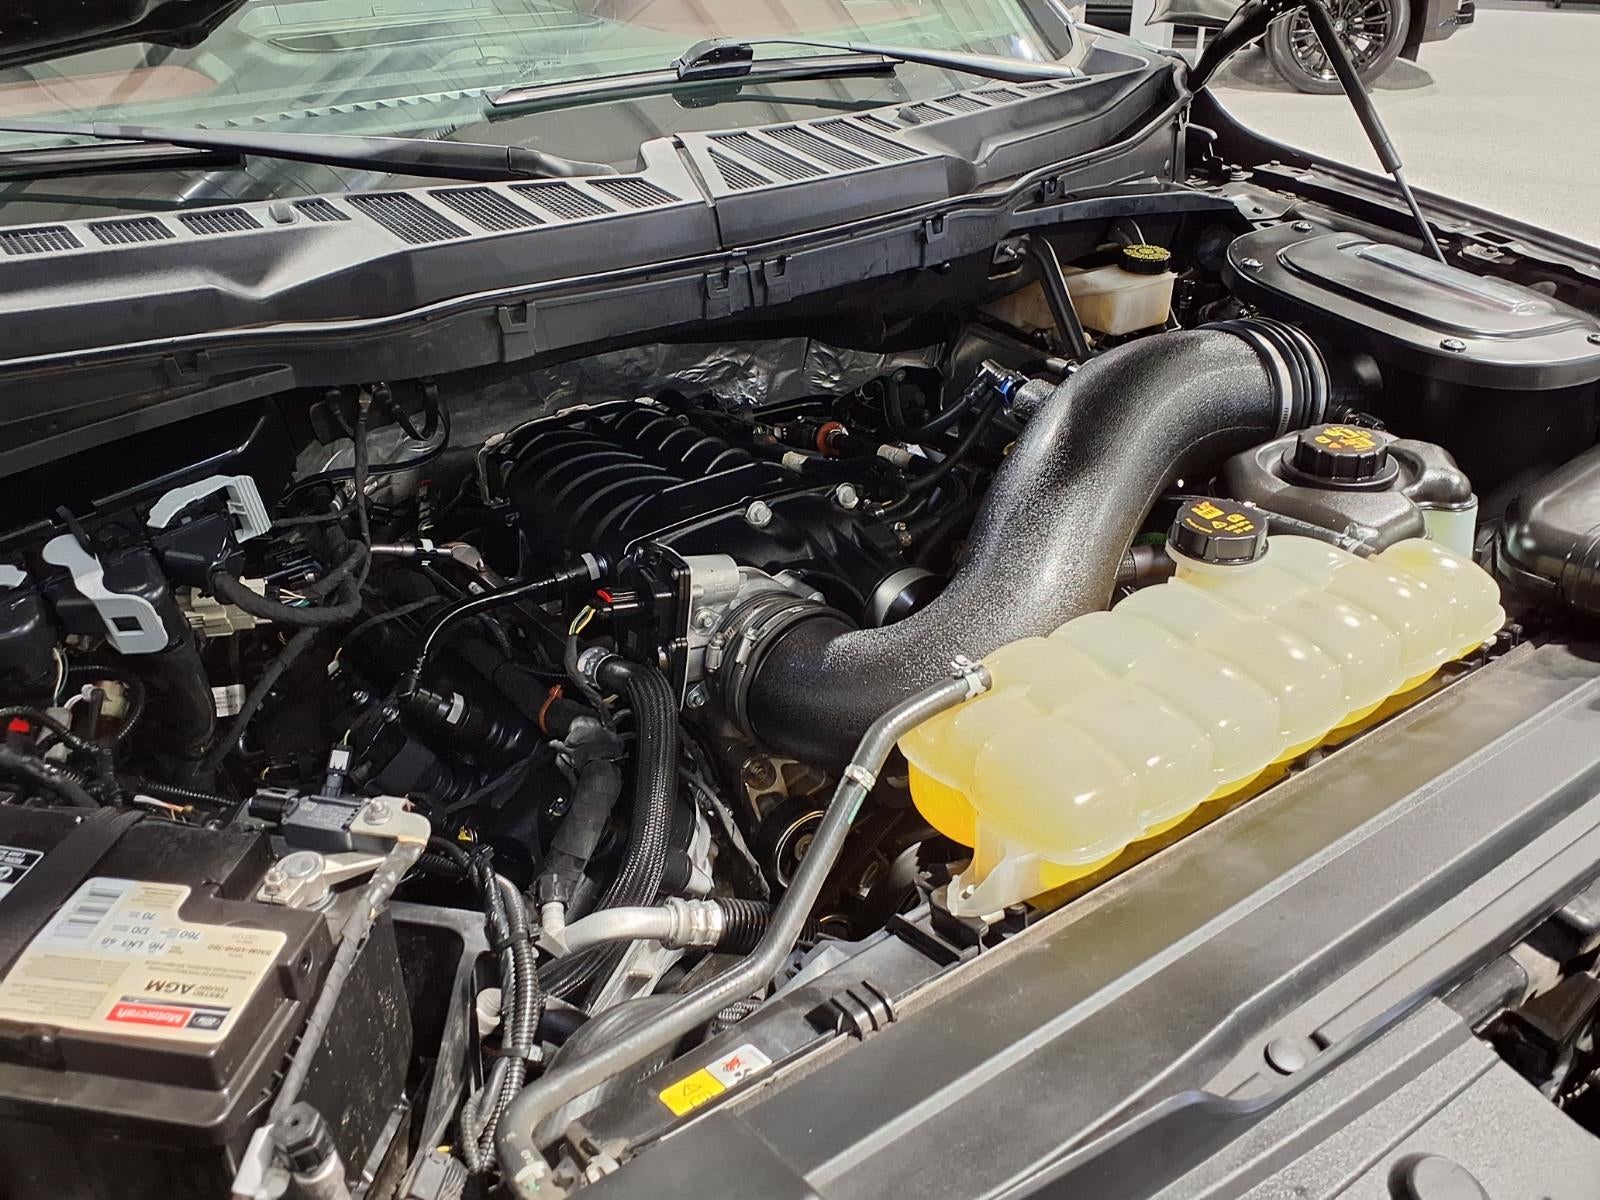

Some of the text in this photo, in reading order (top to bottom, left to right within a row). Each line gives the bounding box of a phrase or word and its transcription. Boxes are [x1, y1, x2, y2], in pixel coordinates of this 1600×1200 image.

[180, 930, 201, 939] 760
[145, 979, 196, 995] AGM
[116, 1007, 184, 1022] Motorcraft
